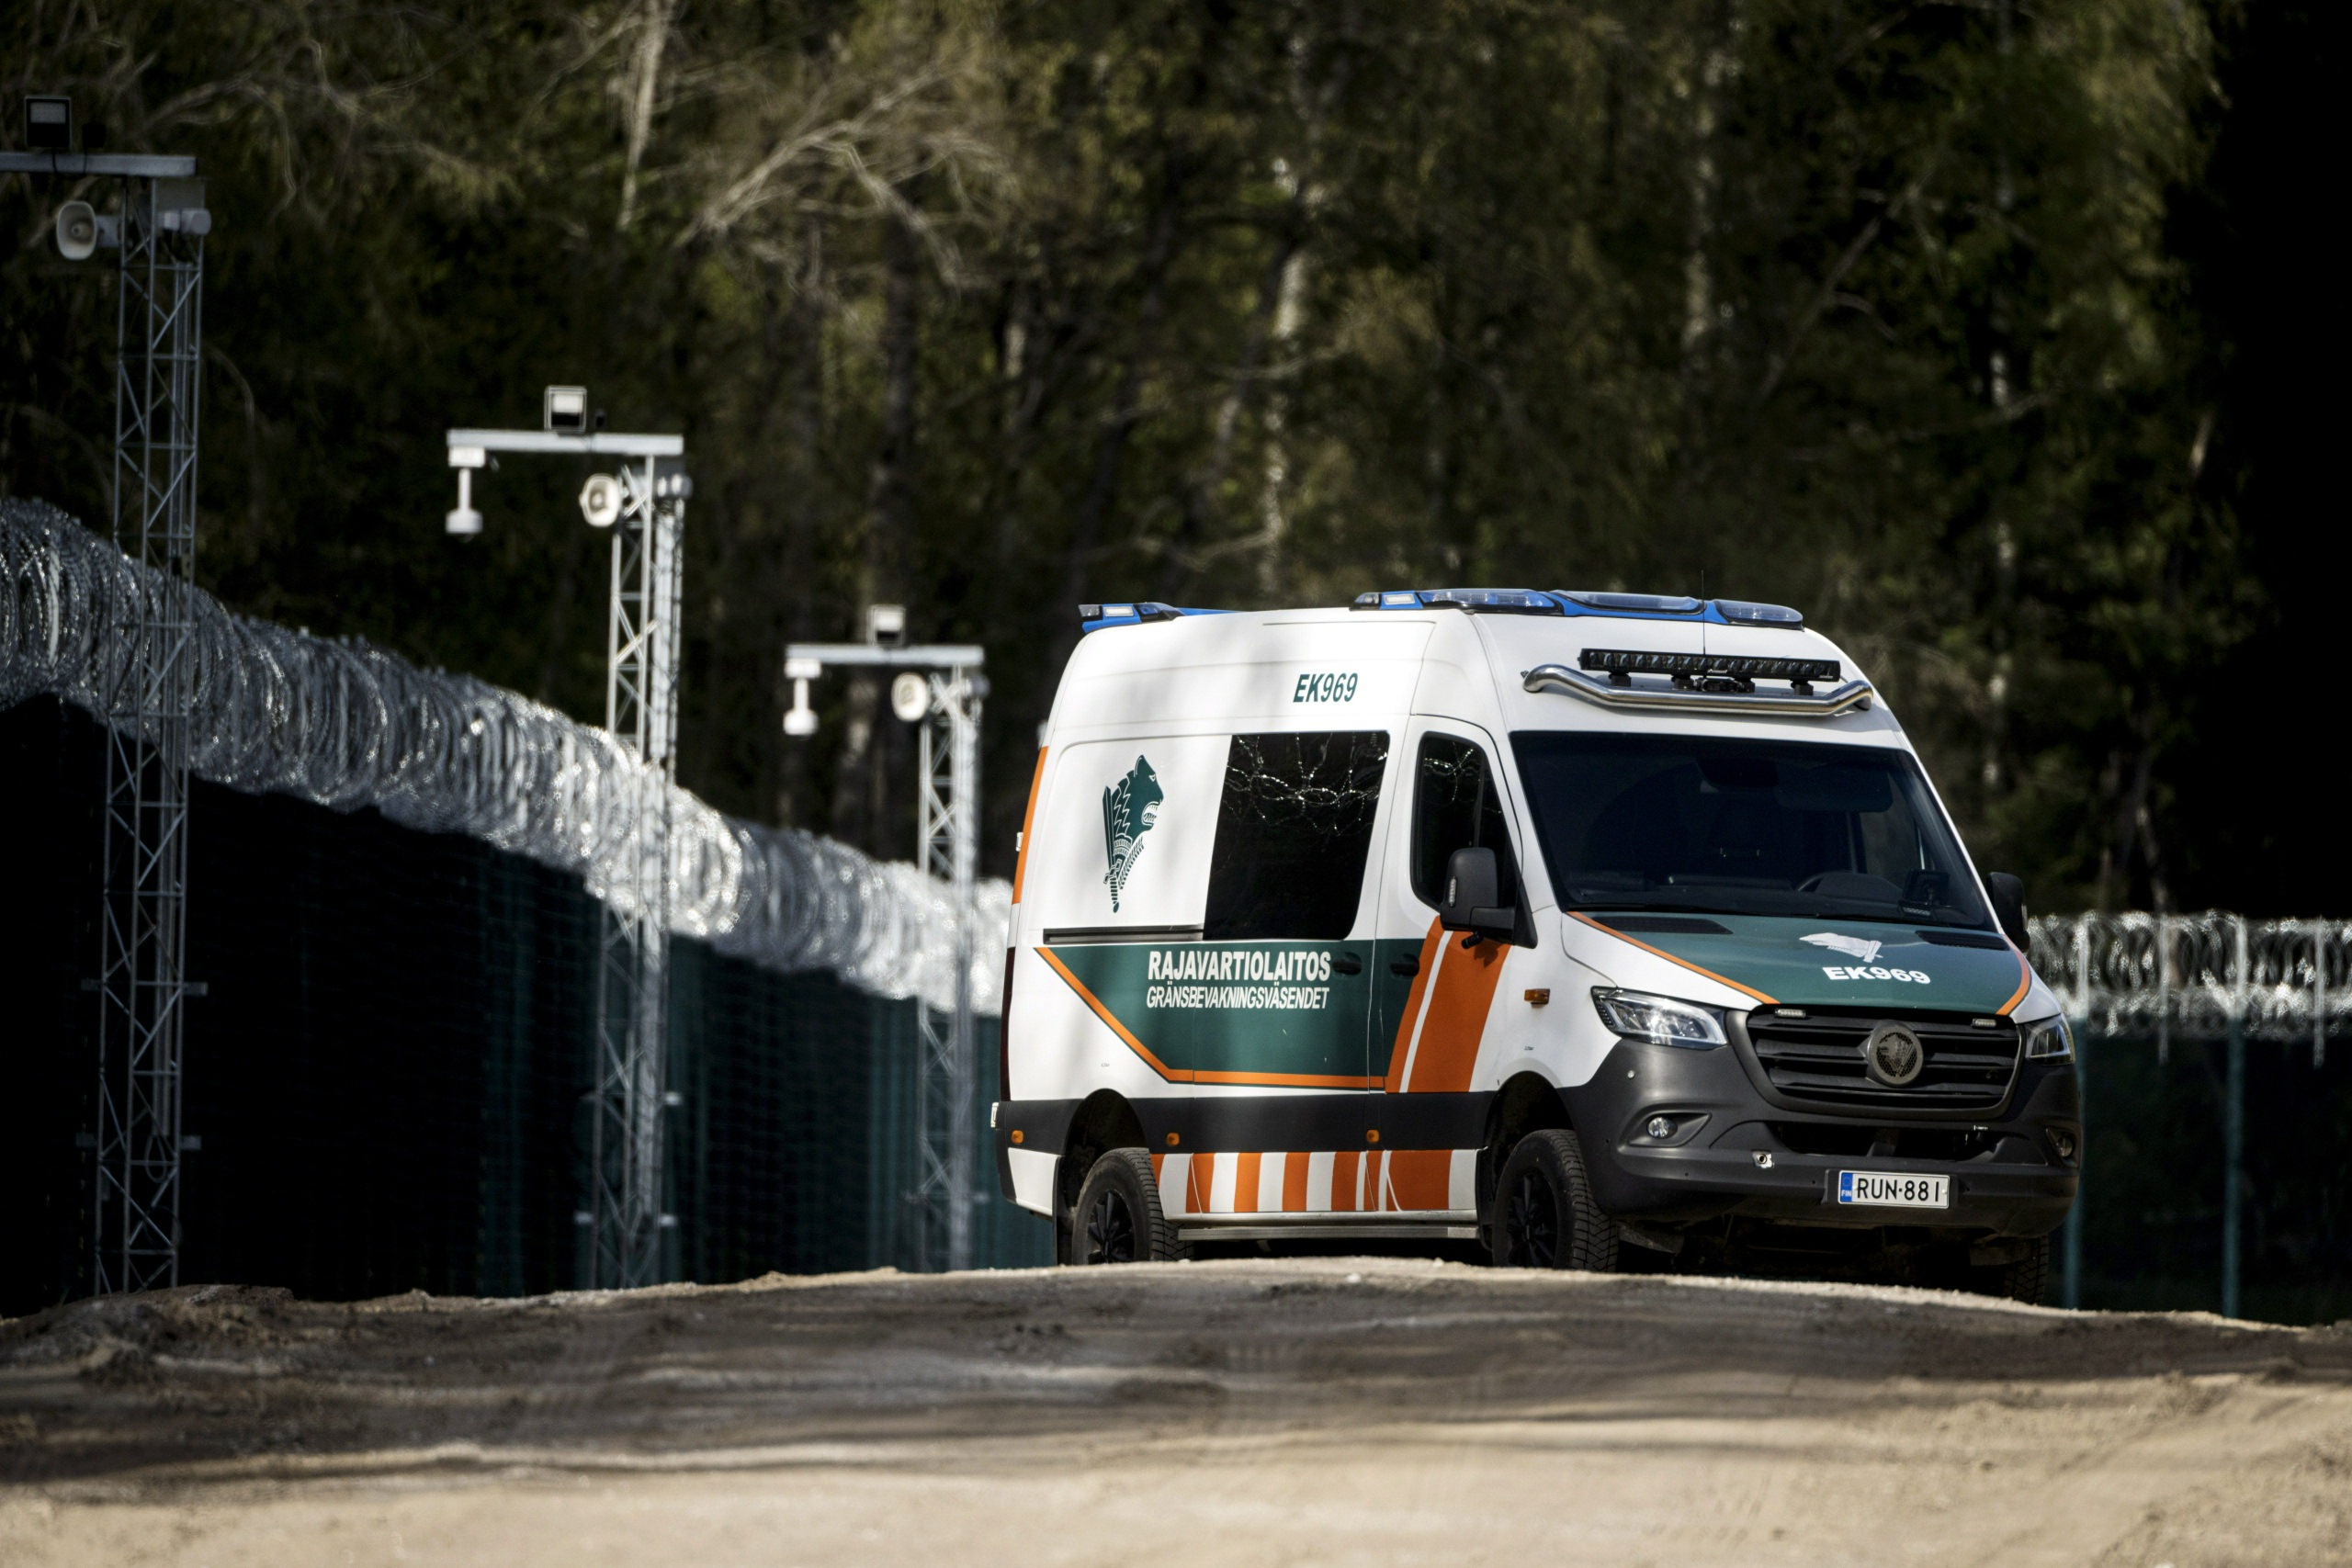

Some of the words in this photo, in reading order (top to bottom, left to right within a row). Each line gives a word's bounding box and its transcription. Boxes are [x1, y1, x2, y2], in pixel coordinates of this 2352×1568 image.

[1293, 672, 1358, 703] EK969
[1148, 951, 1331, 981] RAJAVARTIOLAITOS
[1822, 966, 1931, 984] EK969
[1147, 980, 1329, 1010] GRÄNSBEVAKNINGSVÄSENDET
[1857, 1178, 1939, 1202] RUN-881
